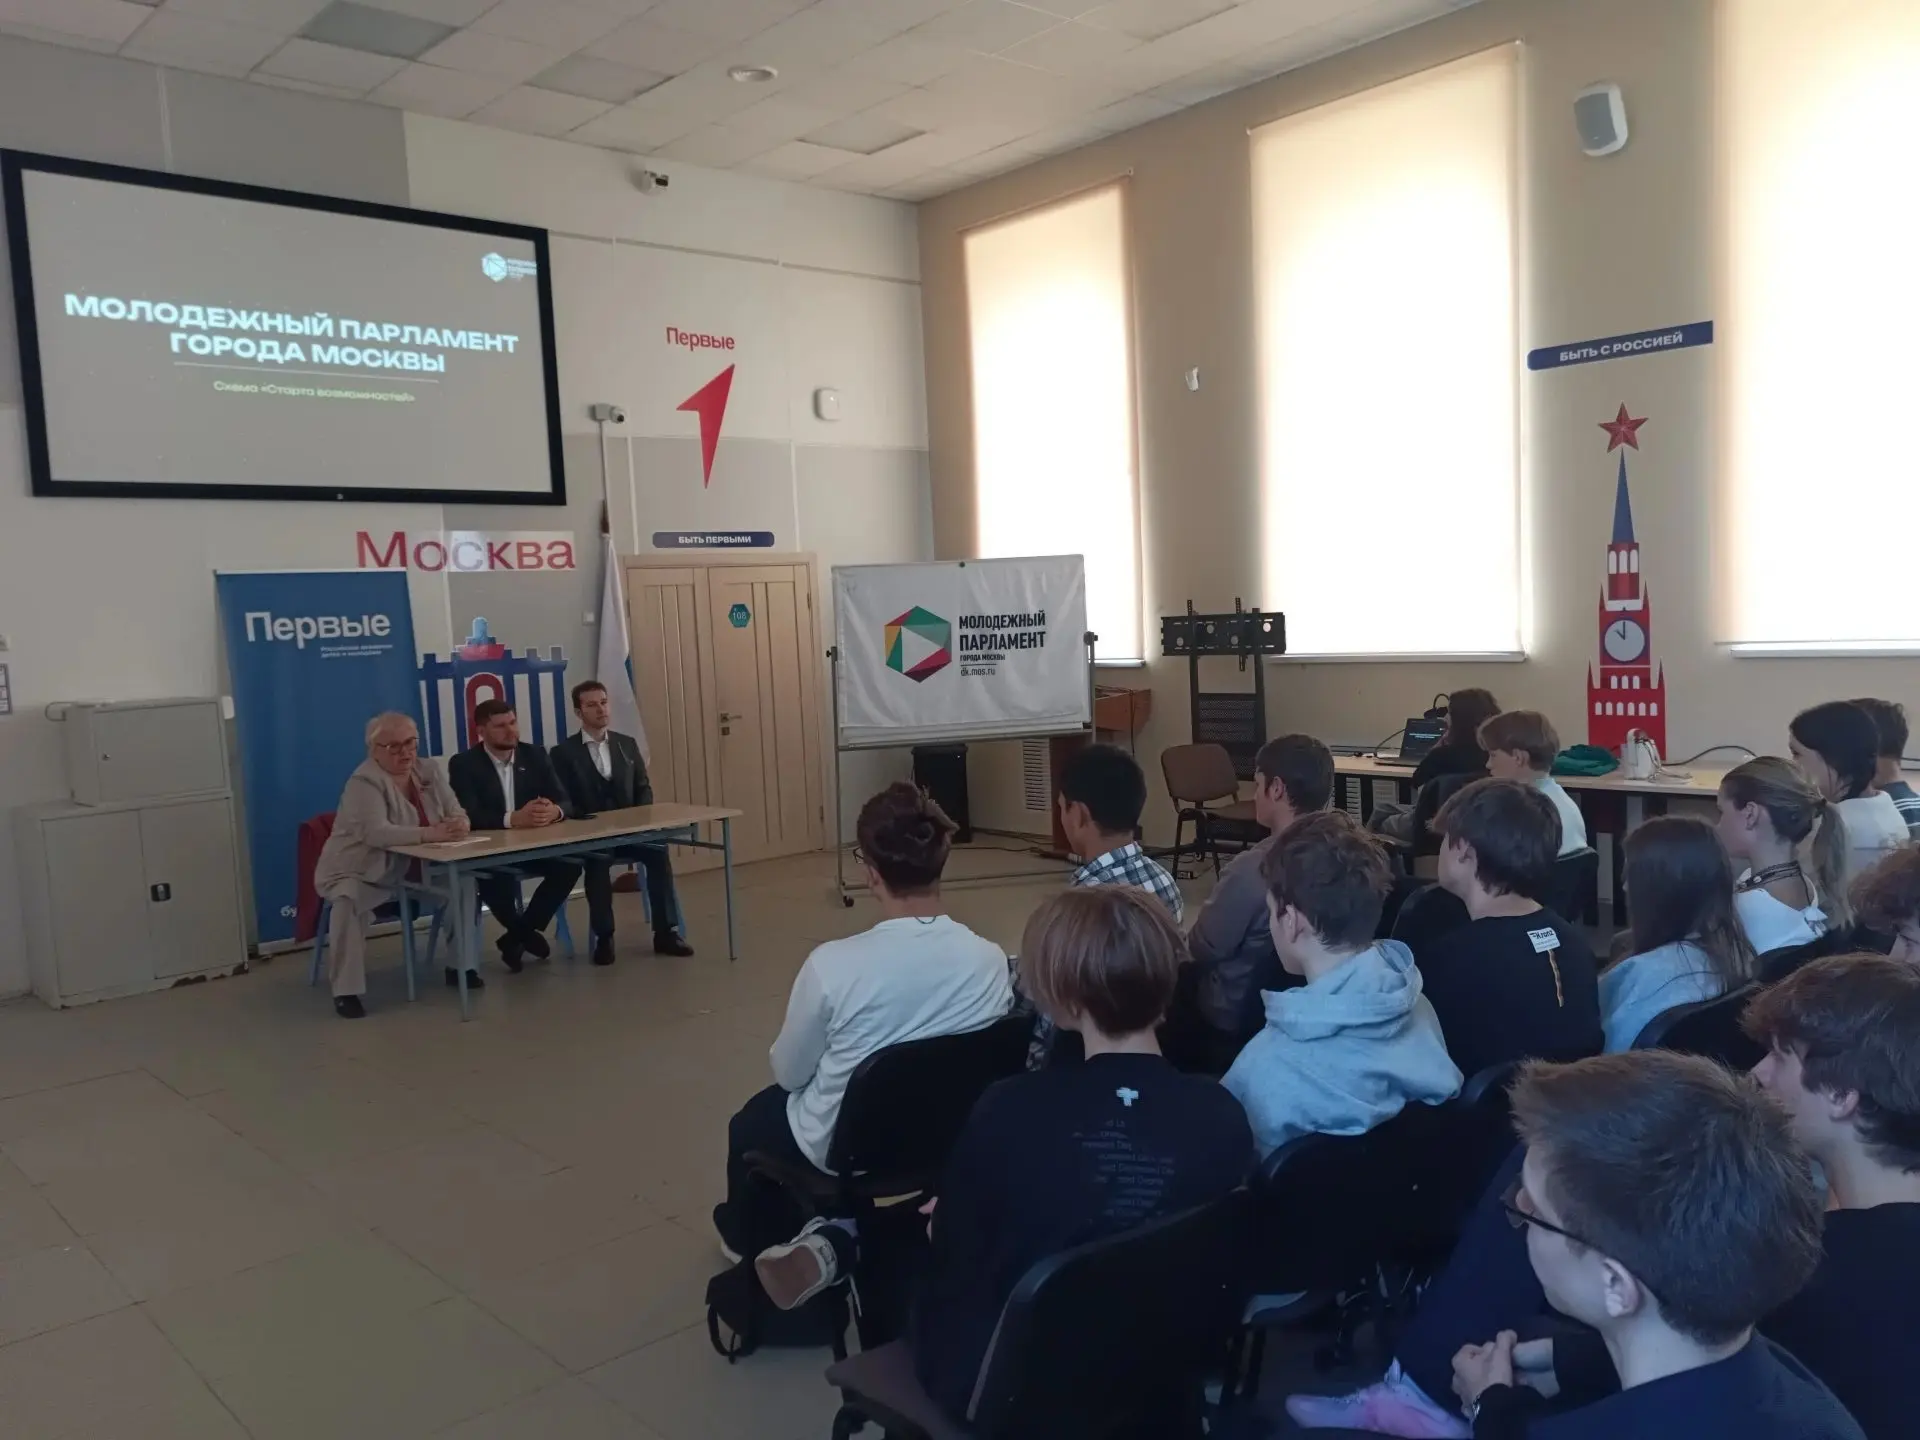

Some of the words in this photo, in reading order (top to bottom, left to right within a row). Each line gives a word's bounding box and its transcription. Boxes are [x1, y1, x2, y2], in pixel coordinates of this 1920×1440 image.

[64, 294, 333, 338] МОЛОДЕЖНЫЙ
[340, 320, 518, 354] ПАРЛАМЕНТ
[666, 326, 735, 351] Первые
[1559, 347, 1598, 362] БЫТЬ
[1600, 345, 1610, 355] С
[1612, 332, 1683, 353] РОССИЕЙ
[170, 333, 305, 364] ГОРОДА
[311, 343, 445, 373] МОСКВЫ
[213, 380, 258, 394] Схема
[356, 531, 576, 571] Москва
[678, 535, 705, 544] БЫТЬ
[706, 535, 752, 544] ПЕРВЫМИ
[245, 611, 391, 649] Первые
[959, 610, 1046, 631] МОЛОДЕЖНЫЙ
[959, 631, 1046, 652] ПАРЛАМЕНТ
[960, 654, 980, 662] ГОРОДА
[981, 653, 1006, 661] МОСКВЫ
[960, 667, 996, 677] dk.mos.ru
